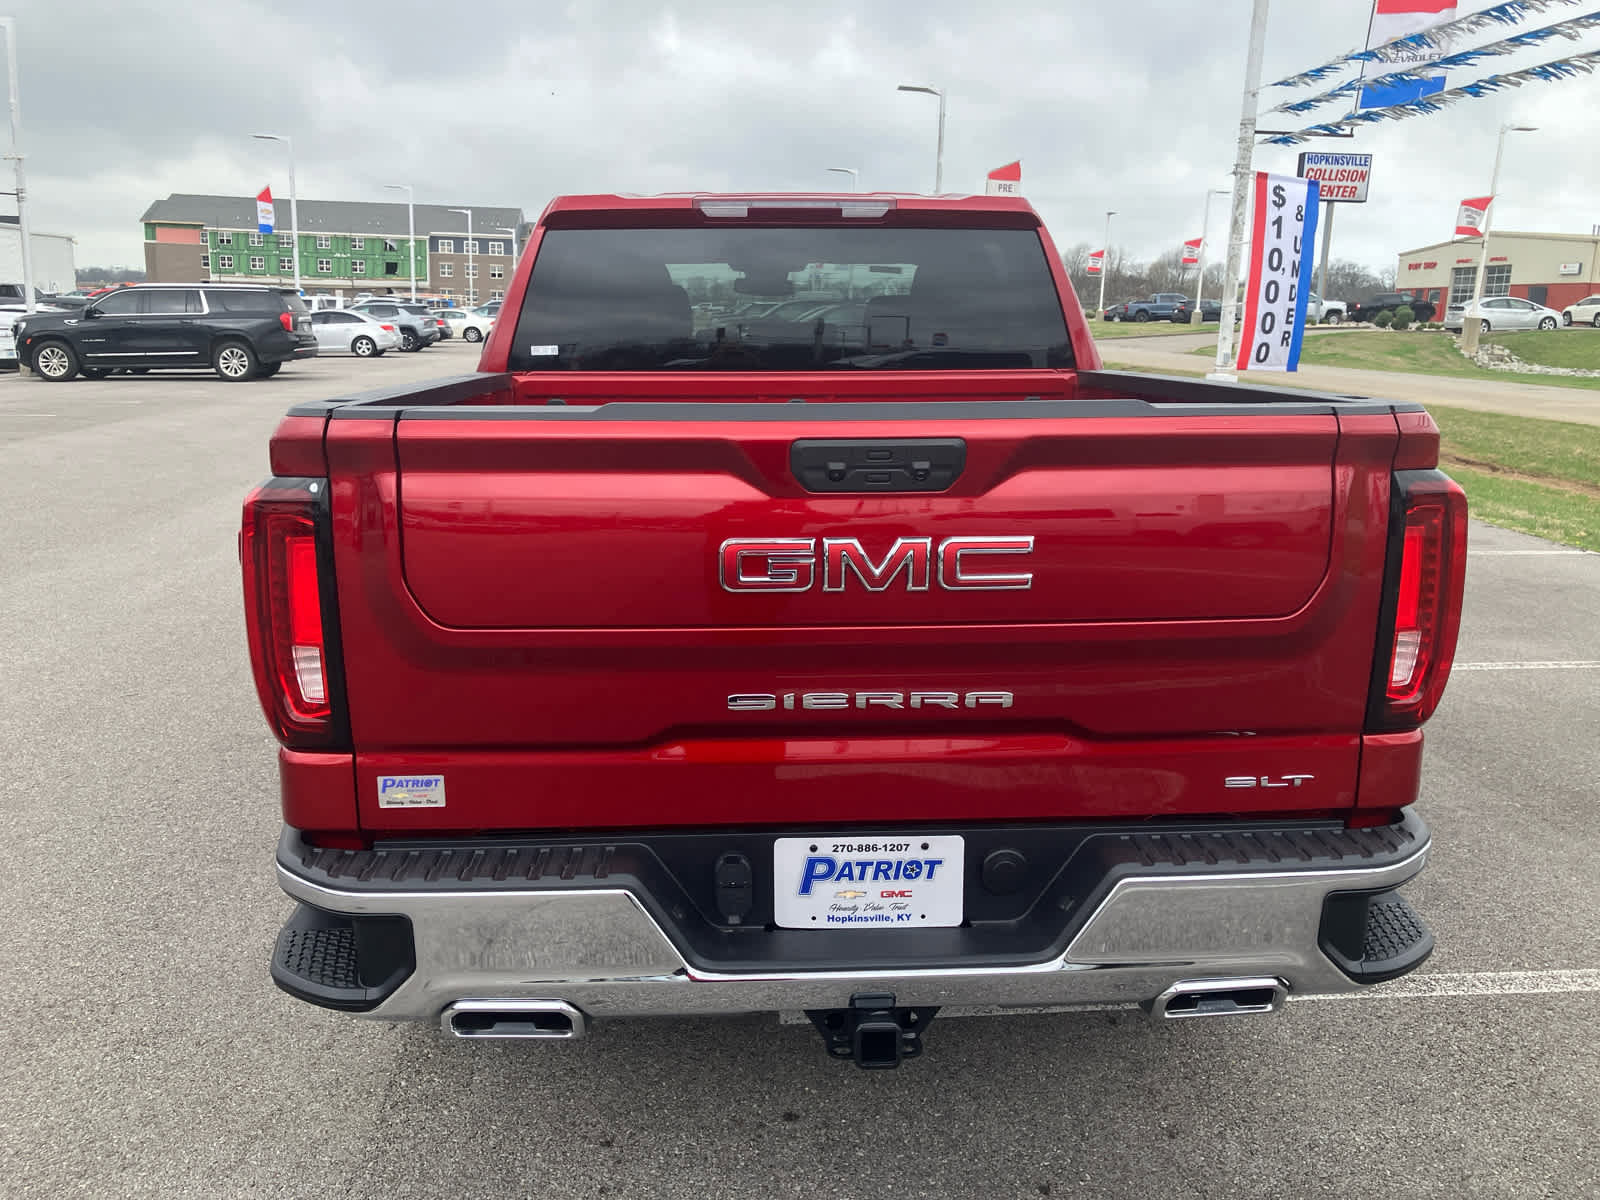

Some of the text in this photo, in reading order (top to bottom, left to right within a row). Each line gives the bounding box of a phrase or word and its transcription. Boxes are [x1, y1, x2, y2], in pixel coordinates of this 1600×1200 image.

[1307, 154, 1369, 166] HOPKINSVILLE
[1305, 167, 1368, 182] COLLISION
[1319, 184, 1357, 198] ENTER
[1295, 204, 1303, 222] &
[1255, 184, 1286, 363] $10,000
[719, 535, 1035, 593] GMC
[727, 691, 1014, 710] SIERRA
[381, 777, 441, 794] PATRIOT
[1224, 774, 1315, 788] SLT
[831, 843, 911, 853] 270-886-1207
[798, 856, 943, 897] PATRIOT
[880, 890, 912, 899] GMC
[826, 913, 912, 924] Hopkinsville, KY
